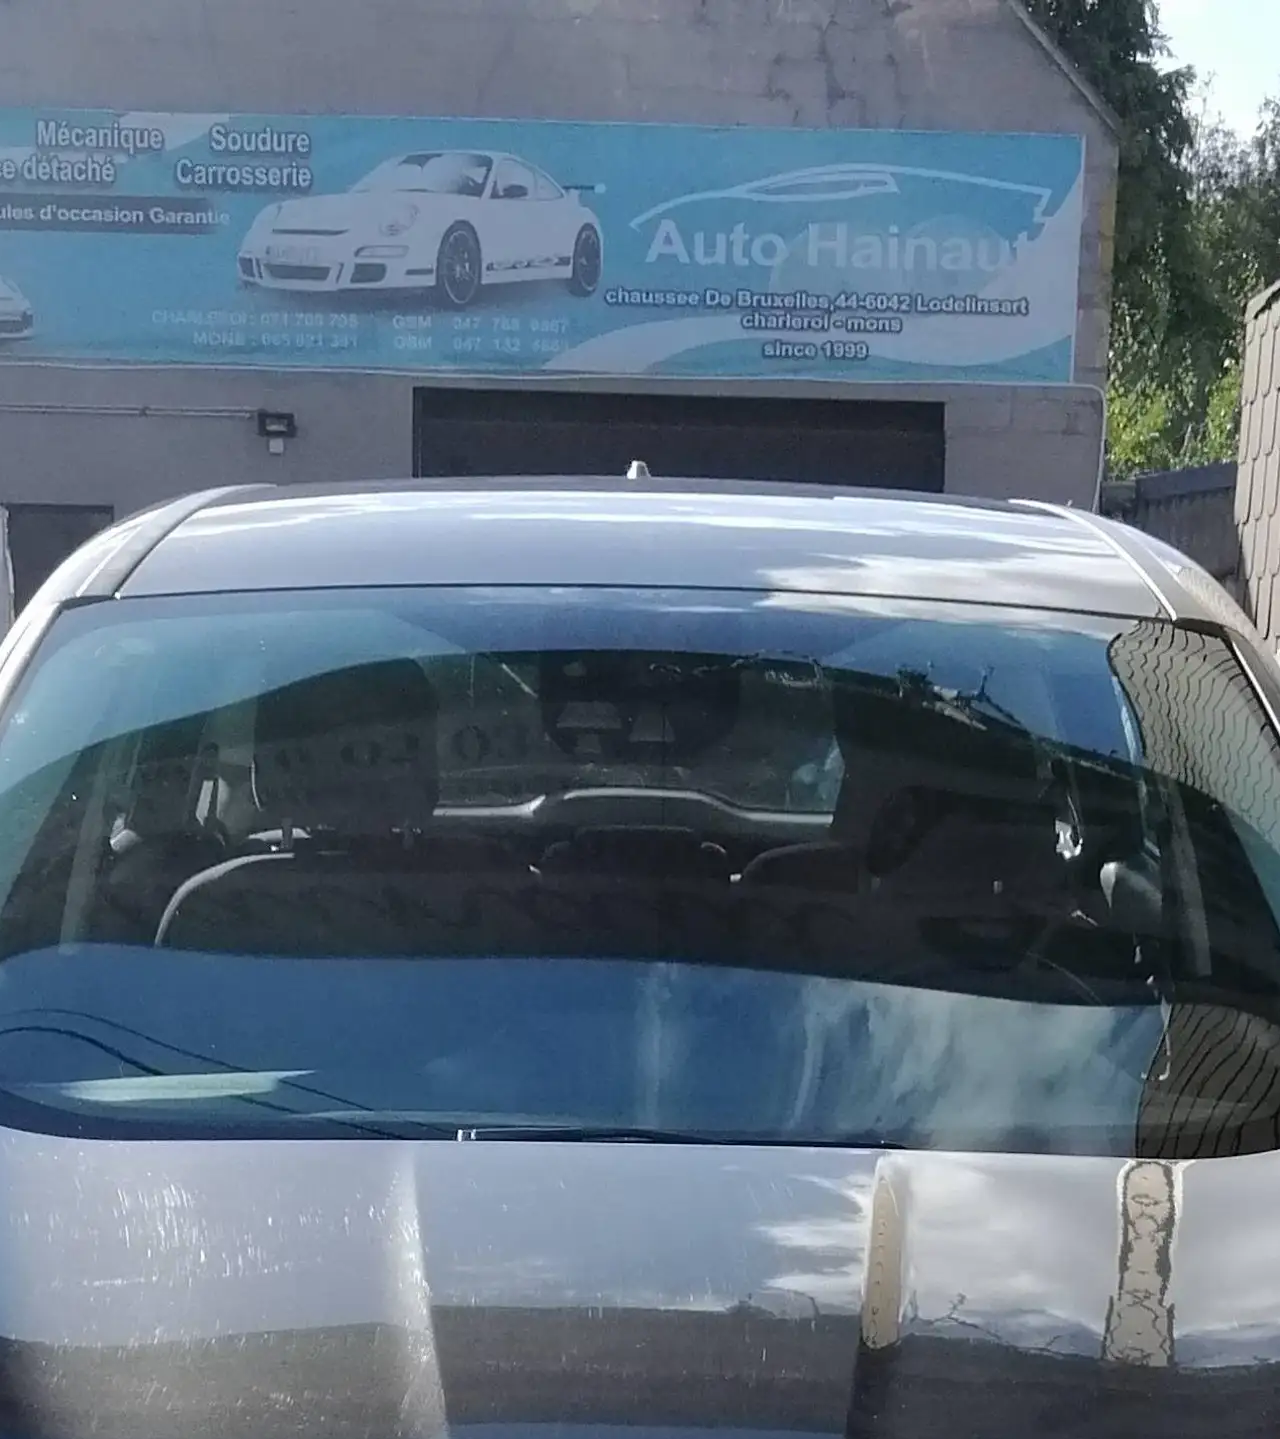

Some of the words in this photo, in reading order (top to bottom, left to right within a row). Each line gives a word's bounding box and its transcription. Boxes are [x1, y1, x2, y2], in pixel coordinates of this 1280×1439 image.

[37, 120, 164, 155] Mécanique
[210, 126, 310, 153] Soudure
[24, 153, 115, 183] détaché
[176, 160, 312, 188] Carrosserie
[40, 204, 143, 224] d'occasion
[645, 219, 789, 266] Auto
[705, 289, 732, 306] De
[917, 295, 1029, 315] Lodelinsart
[847, 317, 902, 332] mons
[763, 340, 816, 358] since
[823, 341, 869, 358] 1999
